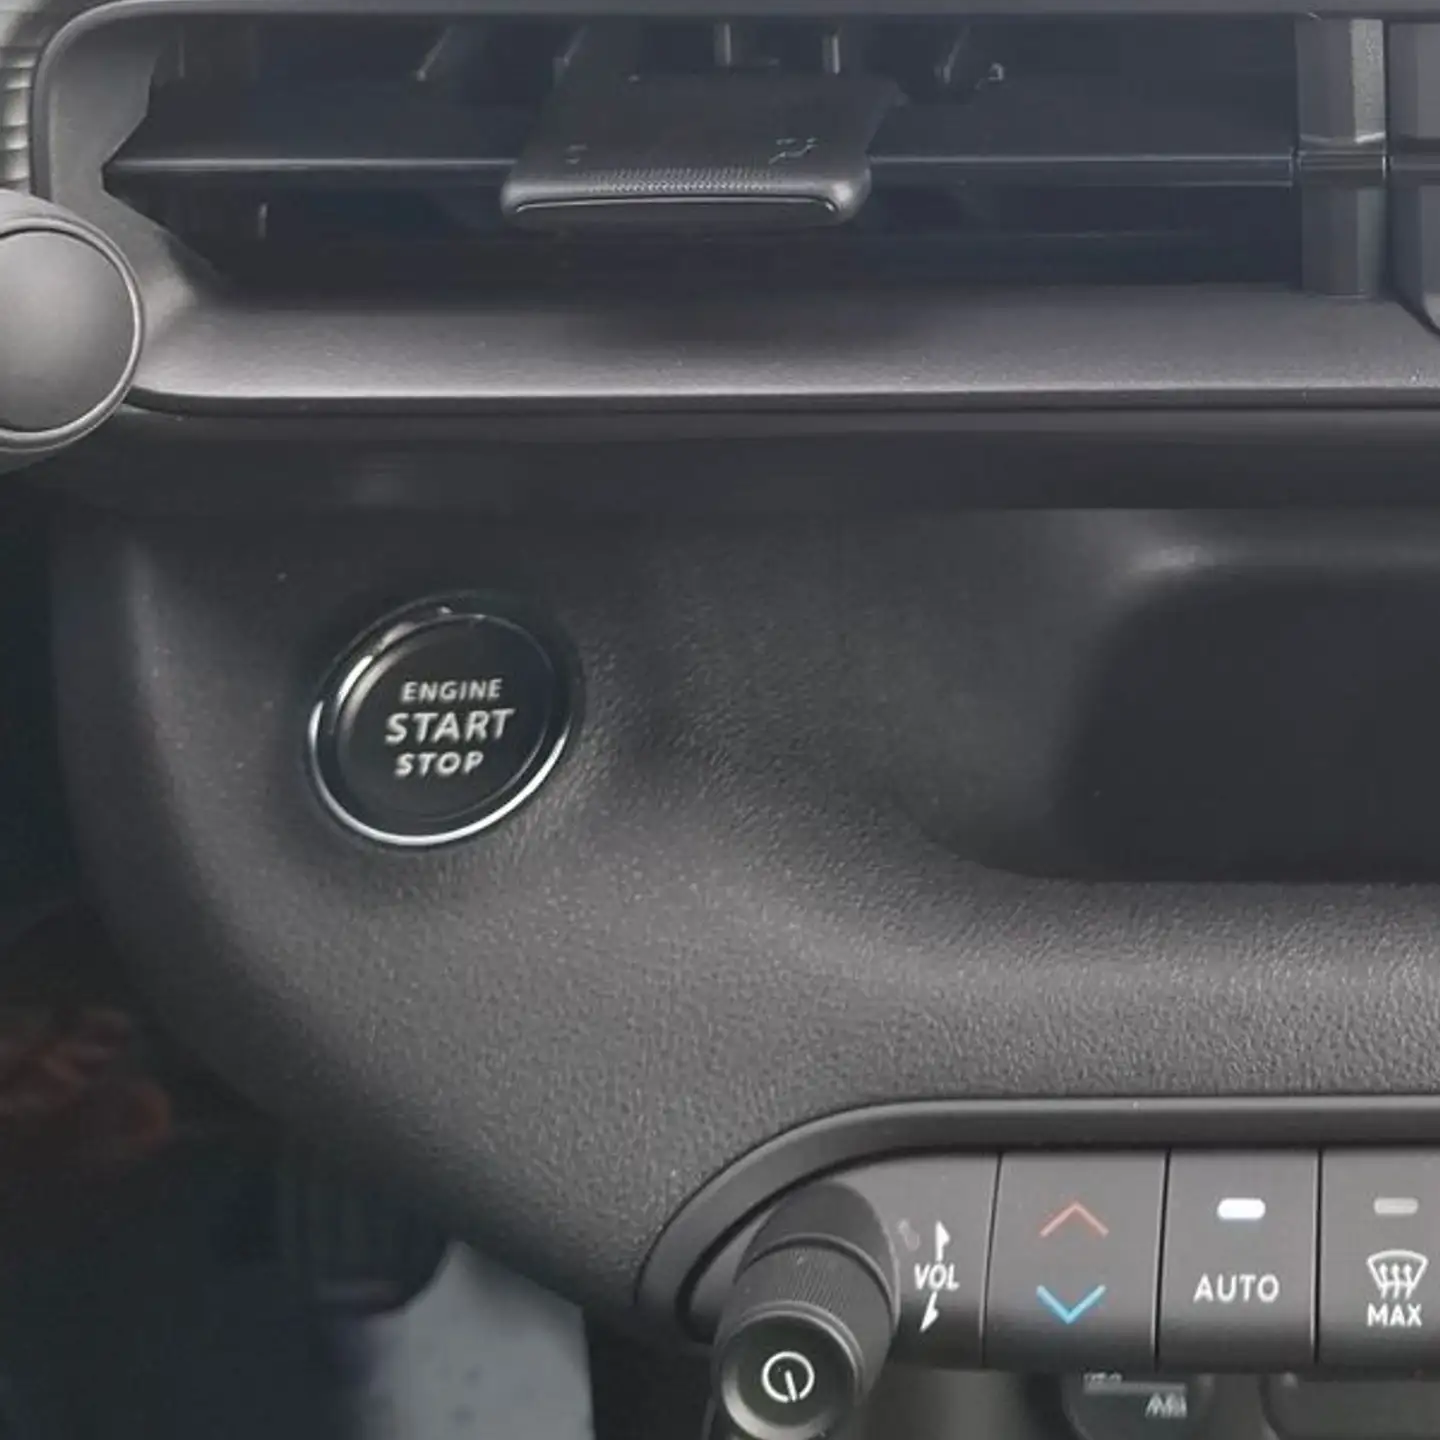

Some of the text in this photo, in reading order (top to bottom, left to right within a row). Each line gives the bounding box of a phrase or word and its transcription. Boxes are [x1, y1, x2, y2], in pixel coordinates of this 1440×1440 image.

[401, 679, 503, 703] ENGINE
[385, 709, 516, 744] START
[395, 751, 484, 777] STOP
[914, 1264, 960, 1291] VOL
[1194, 1275, 1279, 1303] AUTO
[1367, 1303, 1423, 1327] MAX
